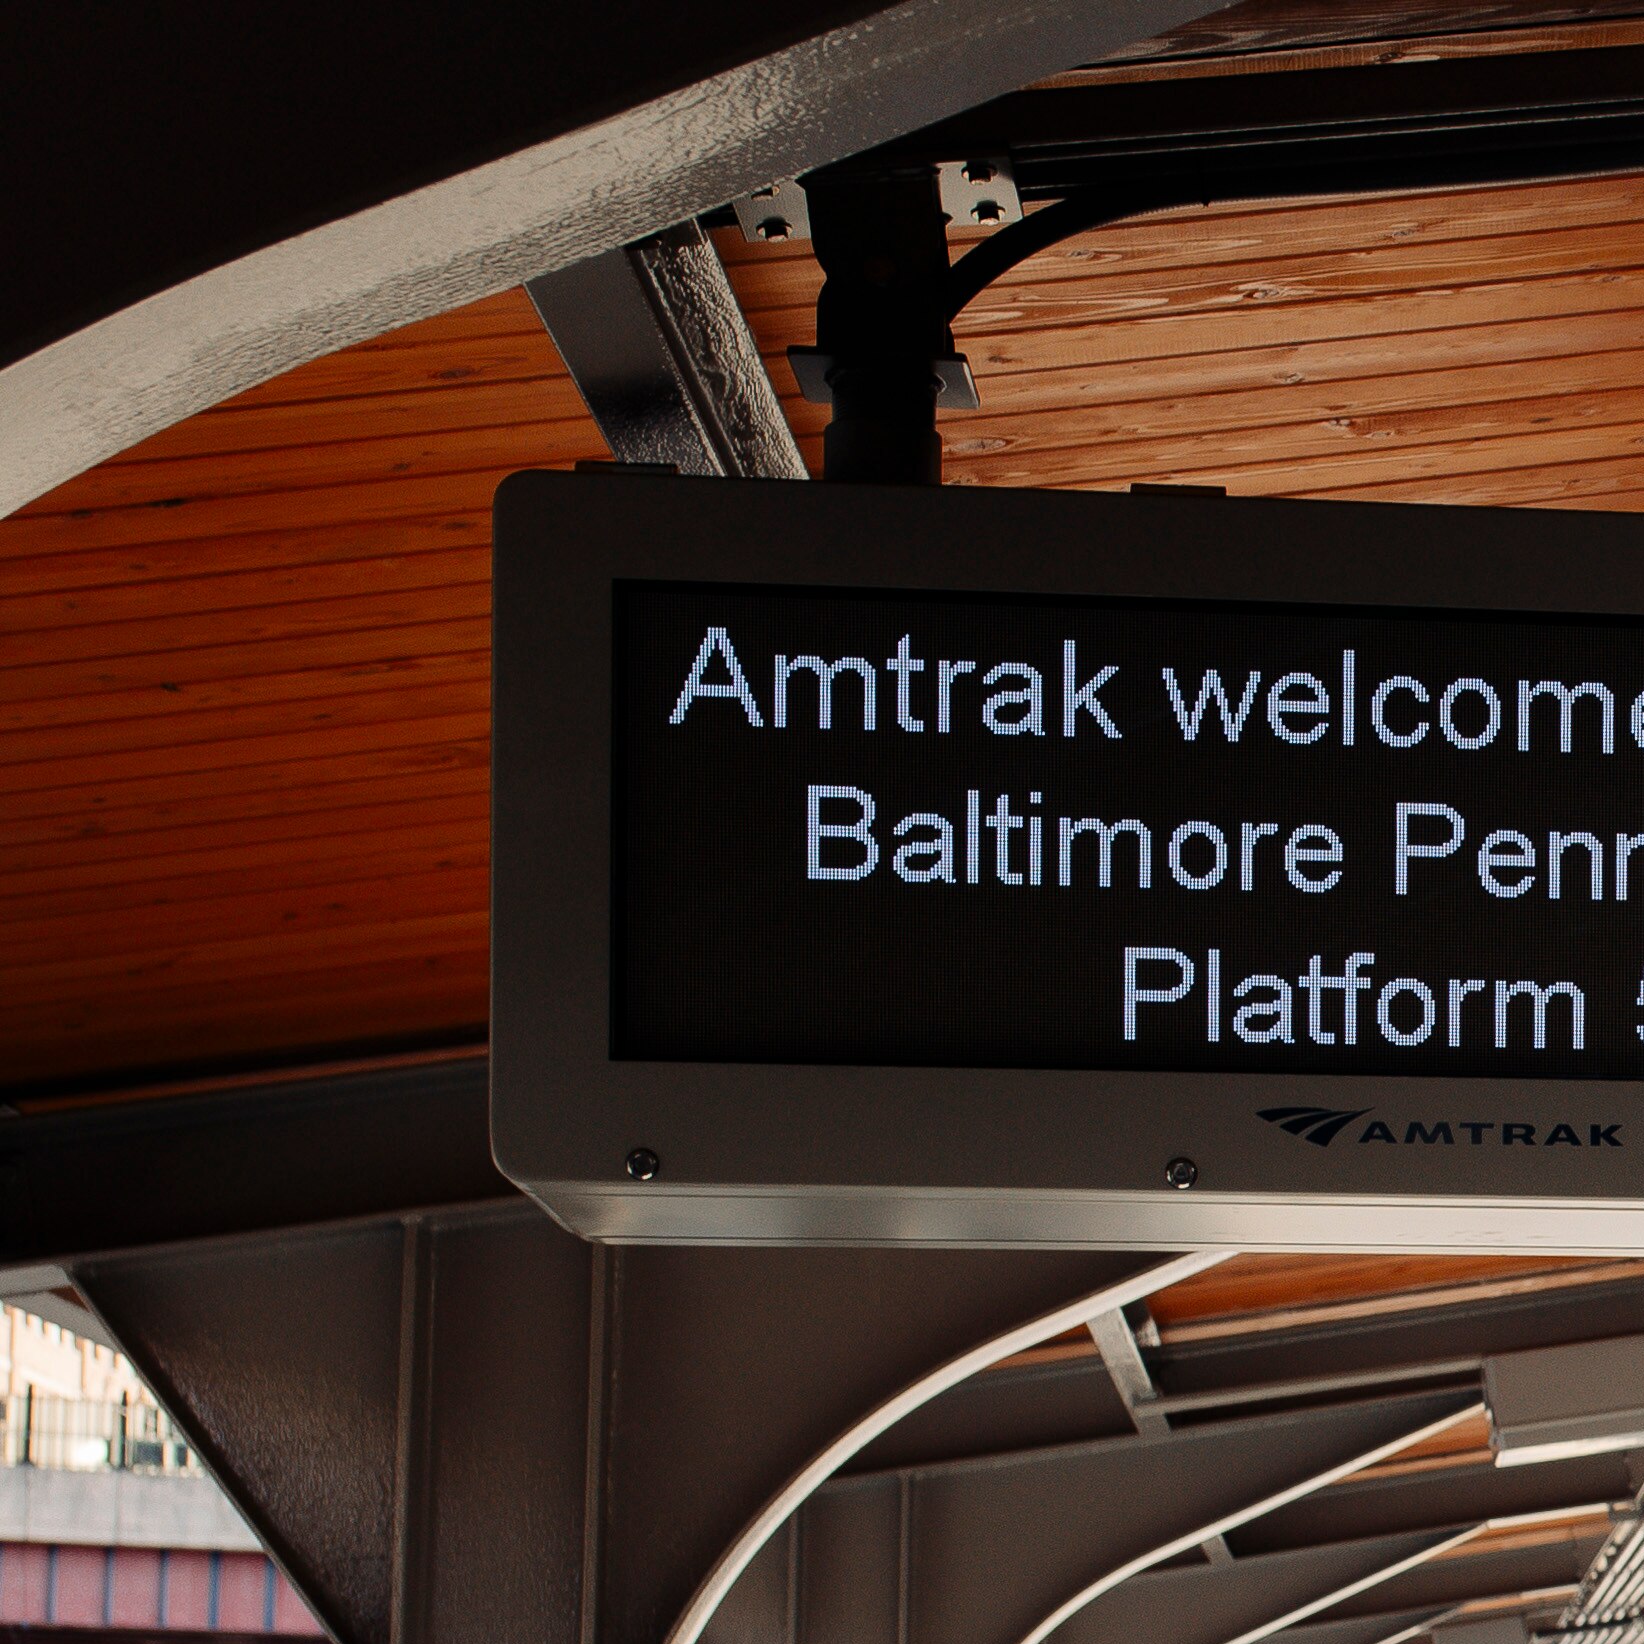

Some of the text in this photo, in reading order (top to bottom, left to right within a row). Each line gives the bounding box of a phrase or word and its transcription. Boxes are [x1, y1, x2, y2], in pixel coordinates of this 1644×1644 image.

[670, 628, 1120, 737] Amtrak
[808, 786, 1342, 891] Baltimore
[1125, 948, 1583, 1048] Platform
[1361, 1124, 1622, 1146] AMTRAK
